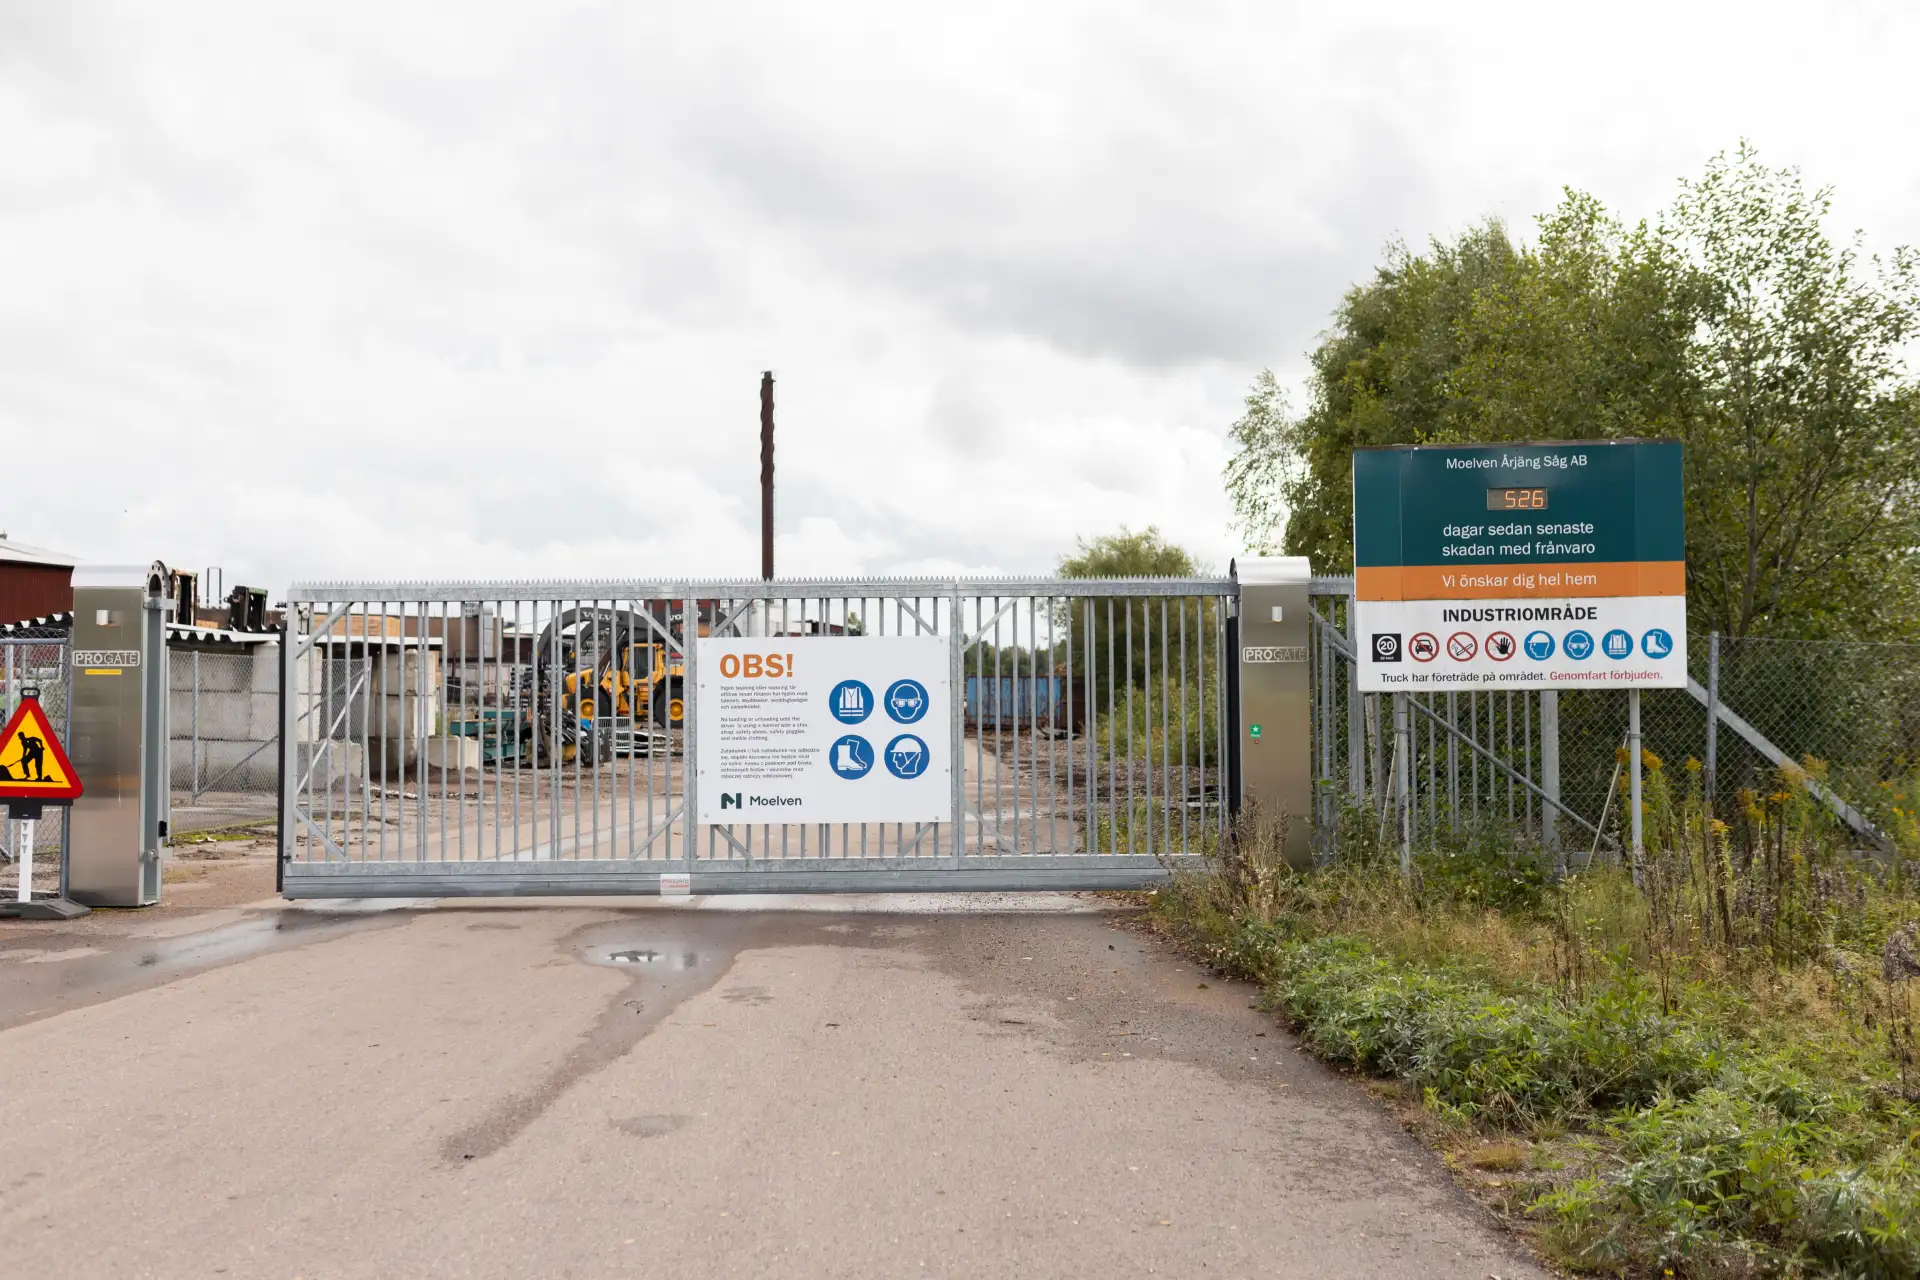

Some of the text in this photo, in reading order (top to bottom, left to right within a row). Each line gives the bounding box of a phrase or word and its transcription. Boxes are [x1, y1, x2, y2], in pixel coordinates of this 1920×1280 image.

[1446, 454, 1588, 470] Moelven Årjäng Såg AB
[1504, 490, 1545, 508] 526
[1443, 522, 1594, 538] dagar sedan senaste
[1442, 540, 1596, 557] skadan med frånvaro
[1442, 573, 1597, 589] Vi önskar dig hel hem
[1442, 604, 1598, 622] INDUSTRIOMRÅDE
[1380, 641, 1393, 651] 20
[75, 653, 137, 664] PROGATE
[1245, 649, 1306, 661] PROGATE
[719, 653, 794, 679] OBS!
[1381, 670, 1663, 683] Truck har företräde på området. Genomfart förbjuden.
[749, 795, 802, 806] Moelven
